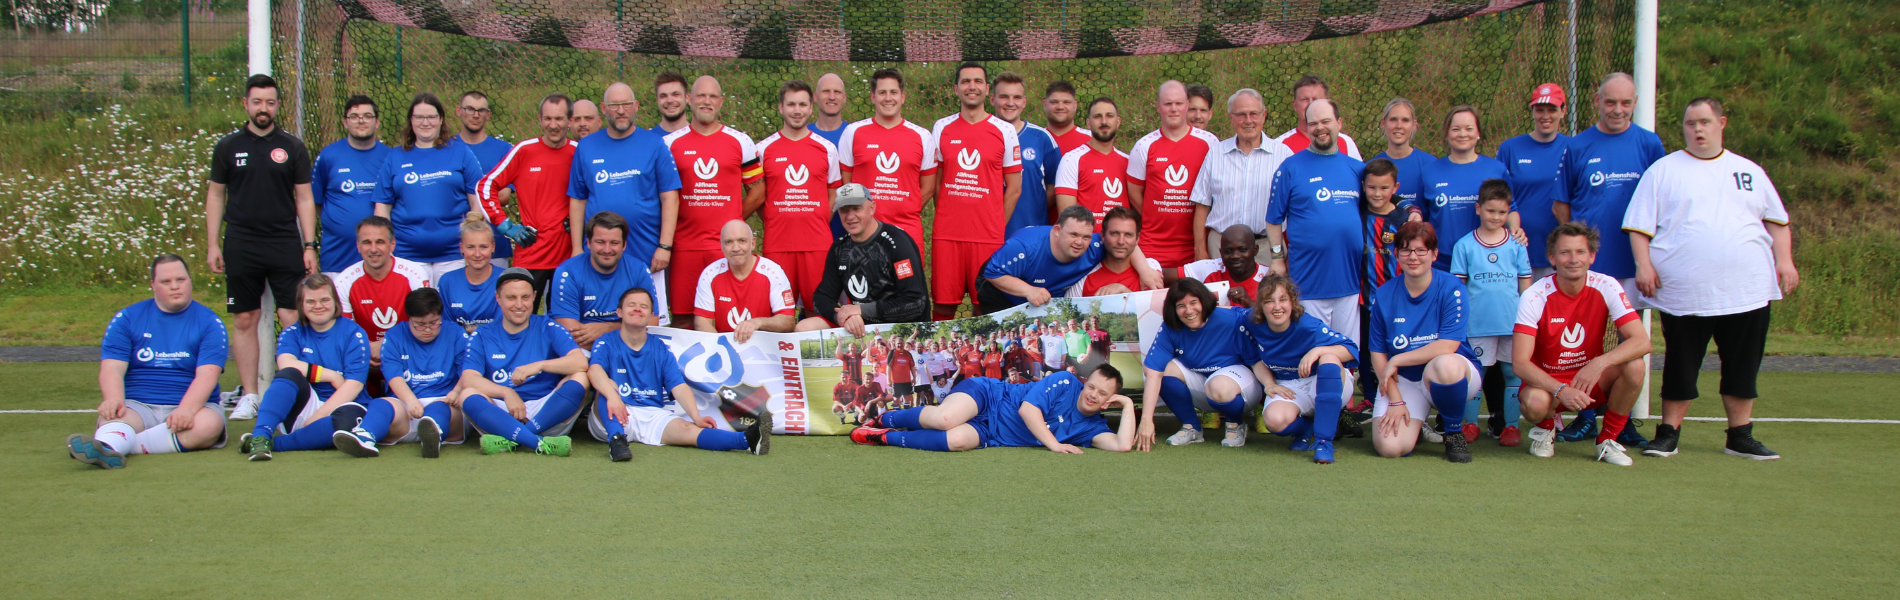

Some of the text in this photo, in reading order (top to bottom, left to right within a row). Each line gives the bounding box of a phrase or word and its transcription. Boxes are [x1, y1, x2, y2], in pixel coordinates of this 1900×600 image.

[419, 171, 452, 179] Lebenshilfe
[610, 169, 641, 178] Lebenshilfe
[1732, 171, 1753, 191] 18
[868, 188, 910, 197] mögensberatung
[944, 182, 990, 194] Vermögensberatung
[1473, 271, 1514, 280] ETIHAD
[1557, 356, 1587, 364] Deutsche
[411, 370, 446, 379] Lebenshilfe
[778, 340, 806, 435] & EINTRACH
[530, 418, 541, 430] AKO
[739, 416, 756, 427] 192
[511, 427, 522, 441] JAKO
